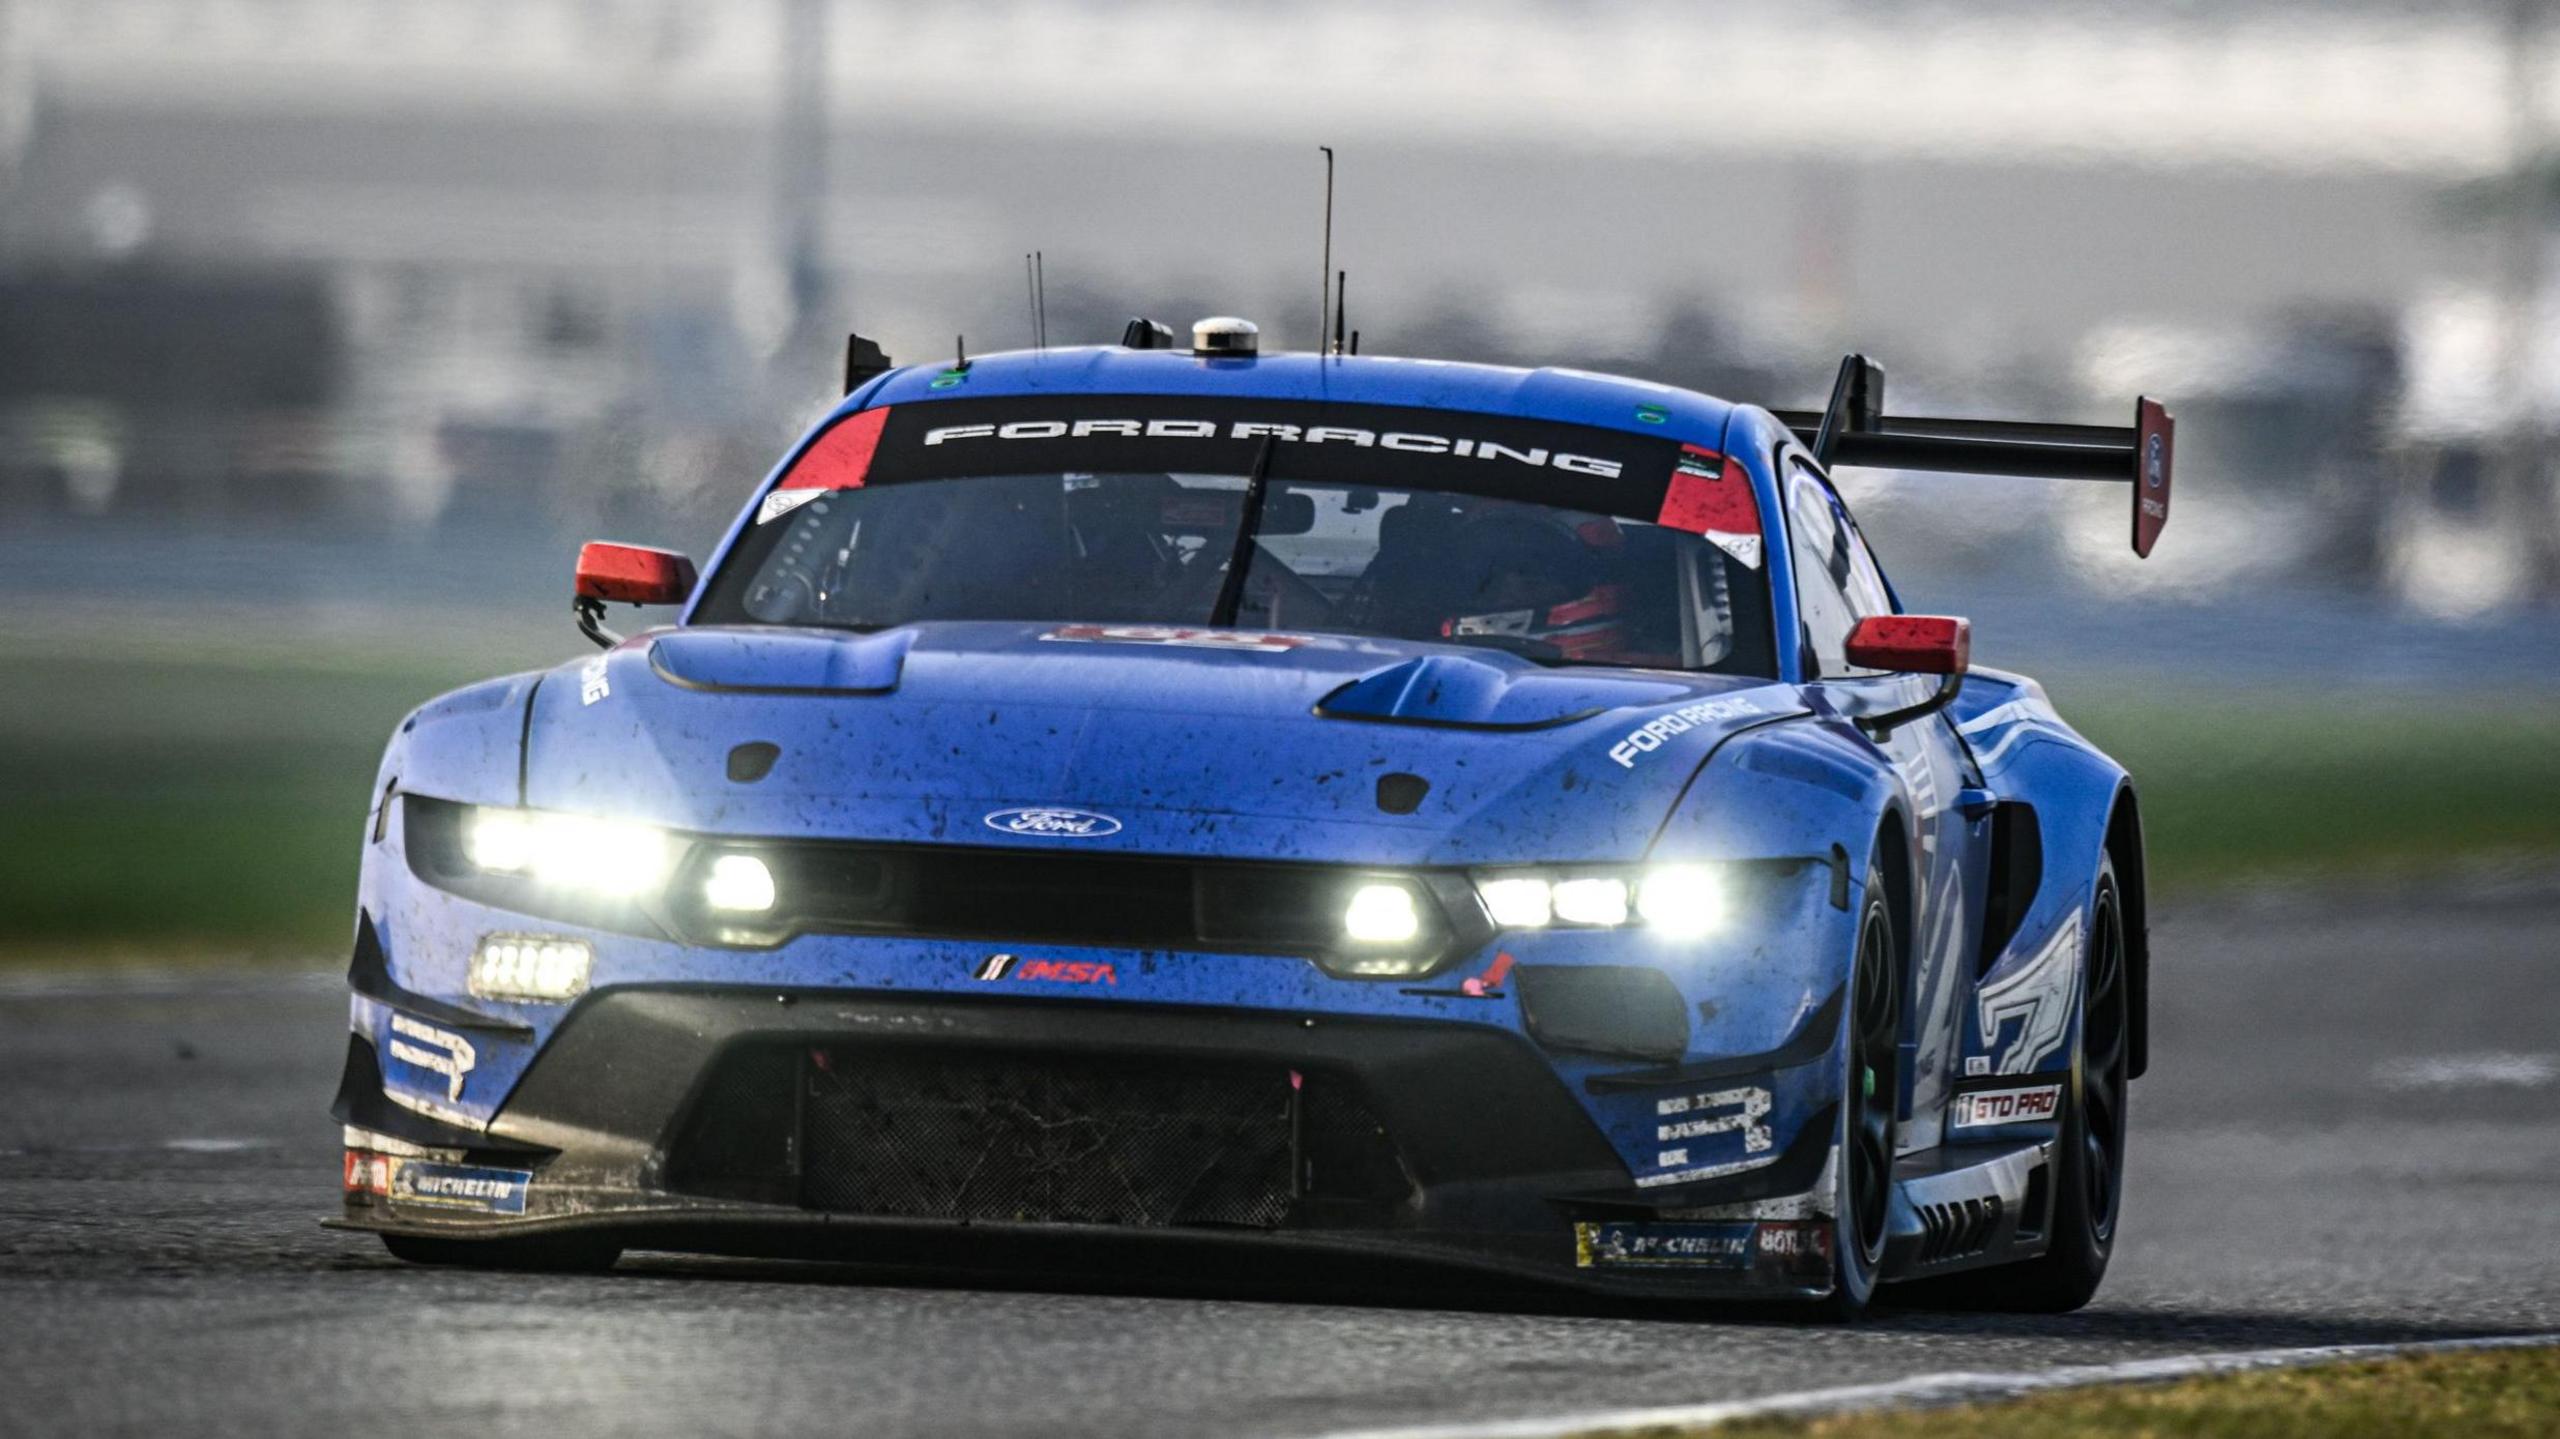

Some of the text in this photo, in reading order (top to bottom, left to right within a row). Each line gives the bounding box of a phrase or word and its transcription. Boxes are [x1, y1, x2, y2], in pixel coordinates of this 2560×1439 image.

[924, 419, 1622, 478] FORD RACING
[1608, 714, 1694, 769] FORD
[1010, 811, 1096, 833] Ford
[2016, 1091, 2056, 1115] PRO
[416, 1175, 512, 1199] MICHELIN
